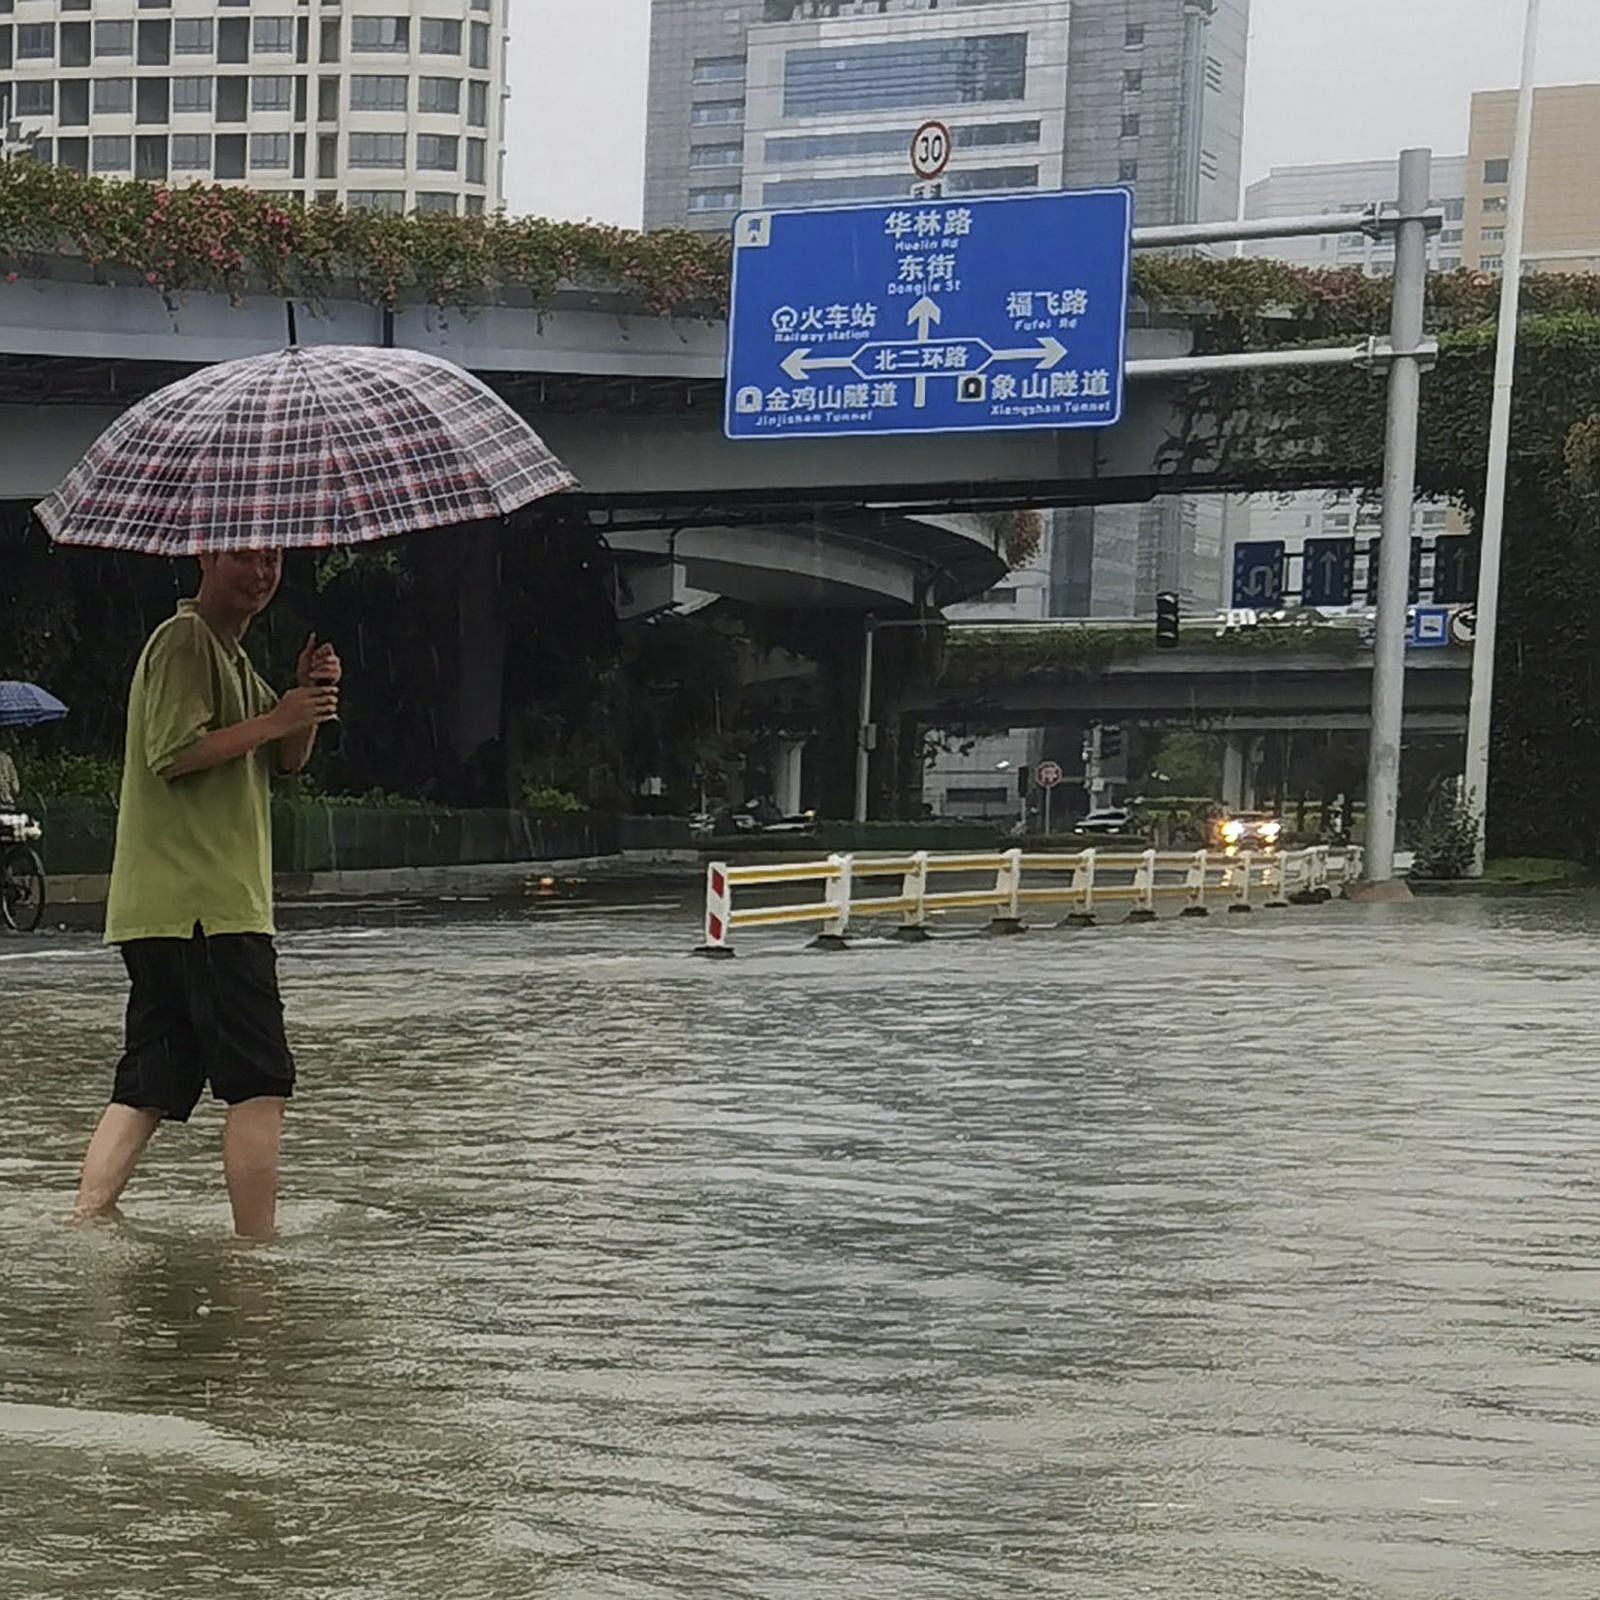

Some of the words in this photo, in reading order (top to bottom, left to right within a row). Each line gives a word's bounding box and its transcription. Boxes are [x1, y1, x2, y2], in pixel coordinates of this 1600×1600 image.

[919, 135, 942, 163] 30
[885, 208, 972, 239] 华林路
[898, 254, 955, 281] 东街
[945, 280, 960, 292] St
[800, 303, 878, 330] 火车站
[1006, 288, 1088, 318] 福飞路
[774, 332, 825, 343] Railway
[875, 346, 968, 371] 北二环路
[765, 382, 898, 411] 金鸡山隧道
[990, 369, 1110, 400] 象山隧道
[825, 411, 872, 422] Tunnel
[1065, 401, 1110, 413] Tunnel
